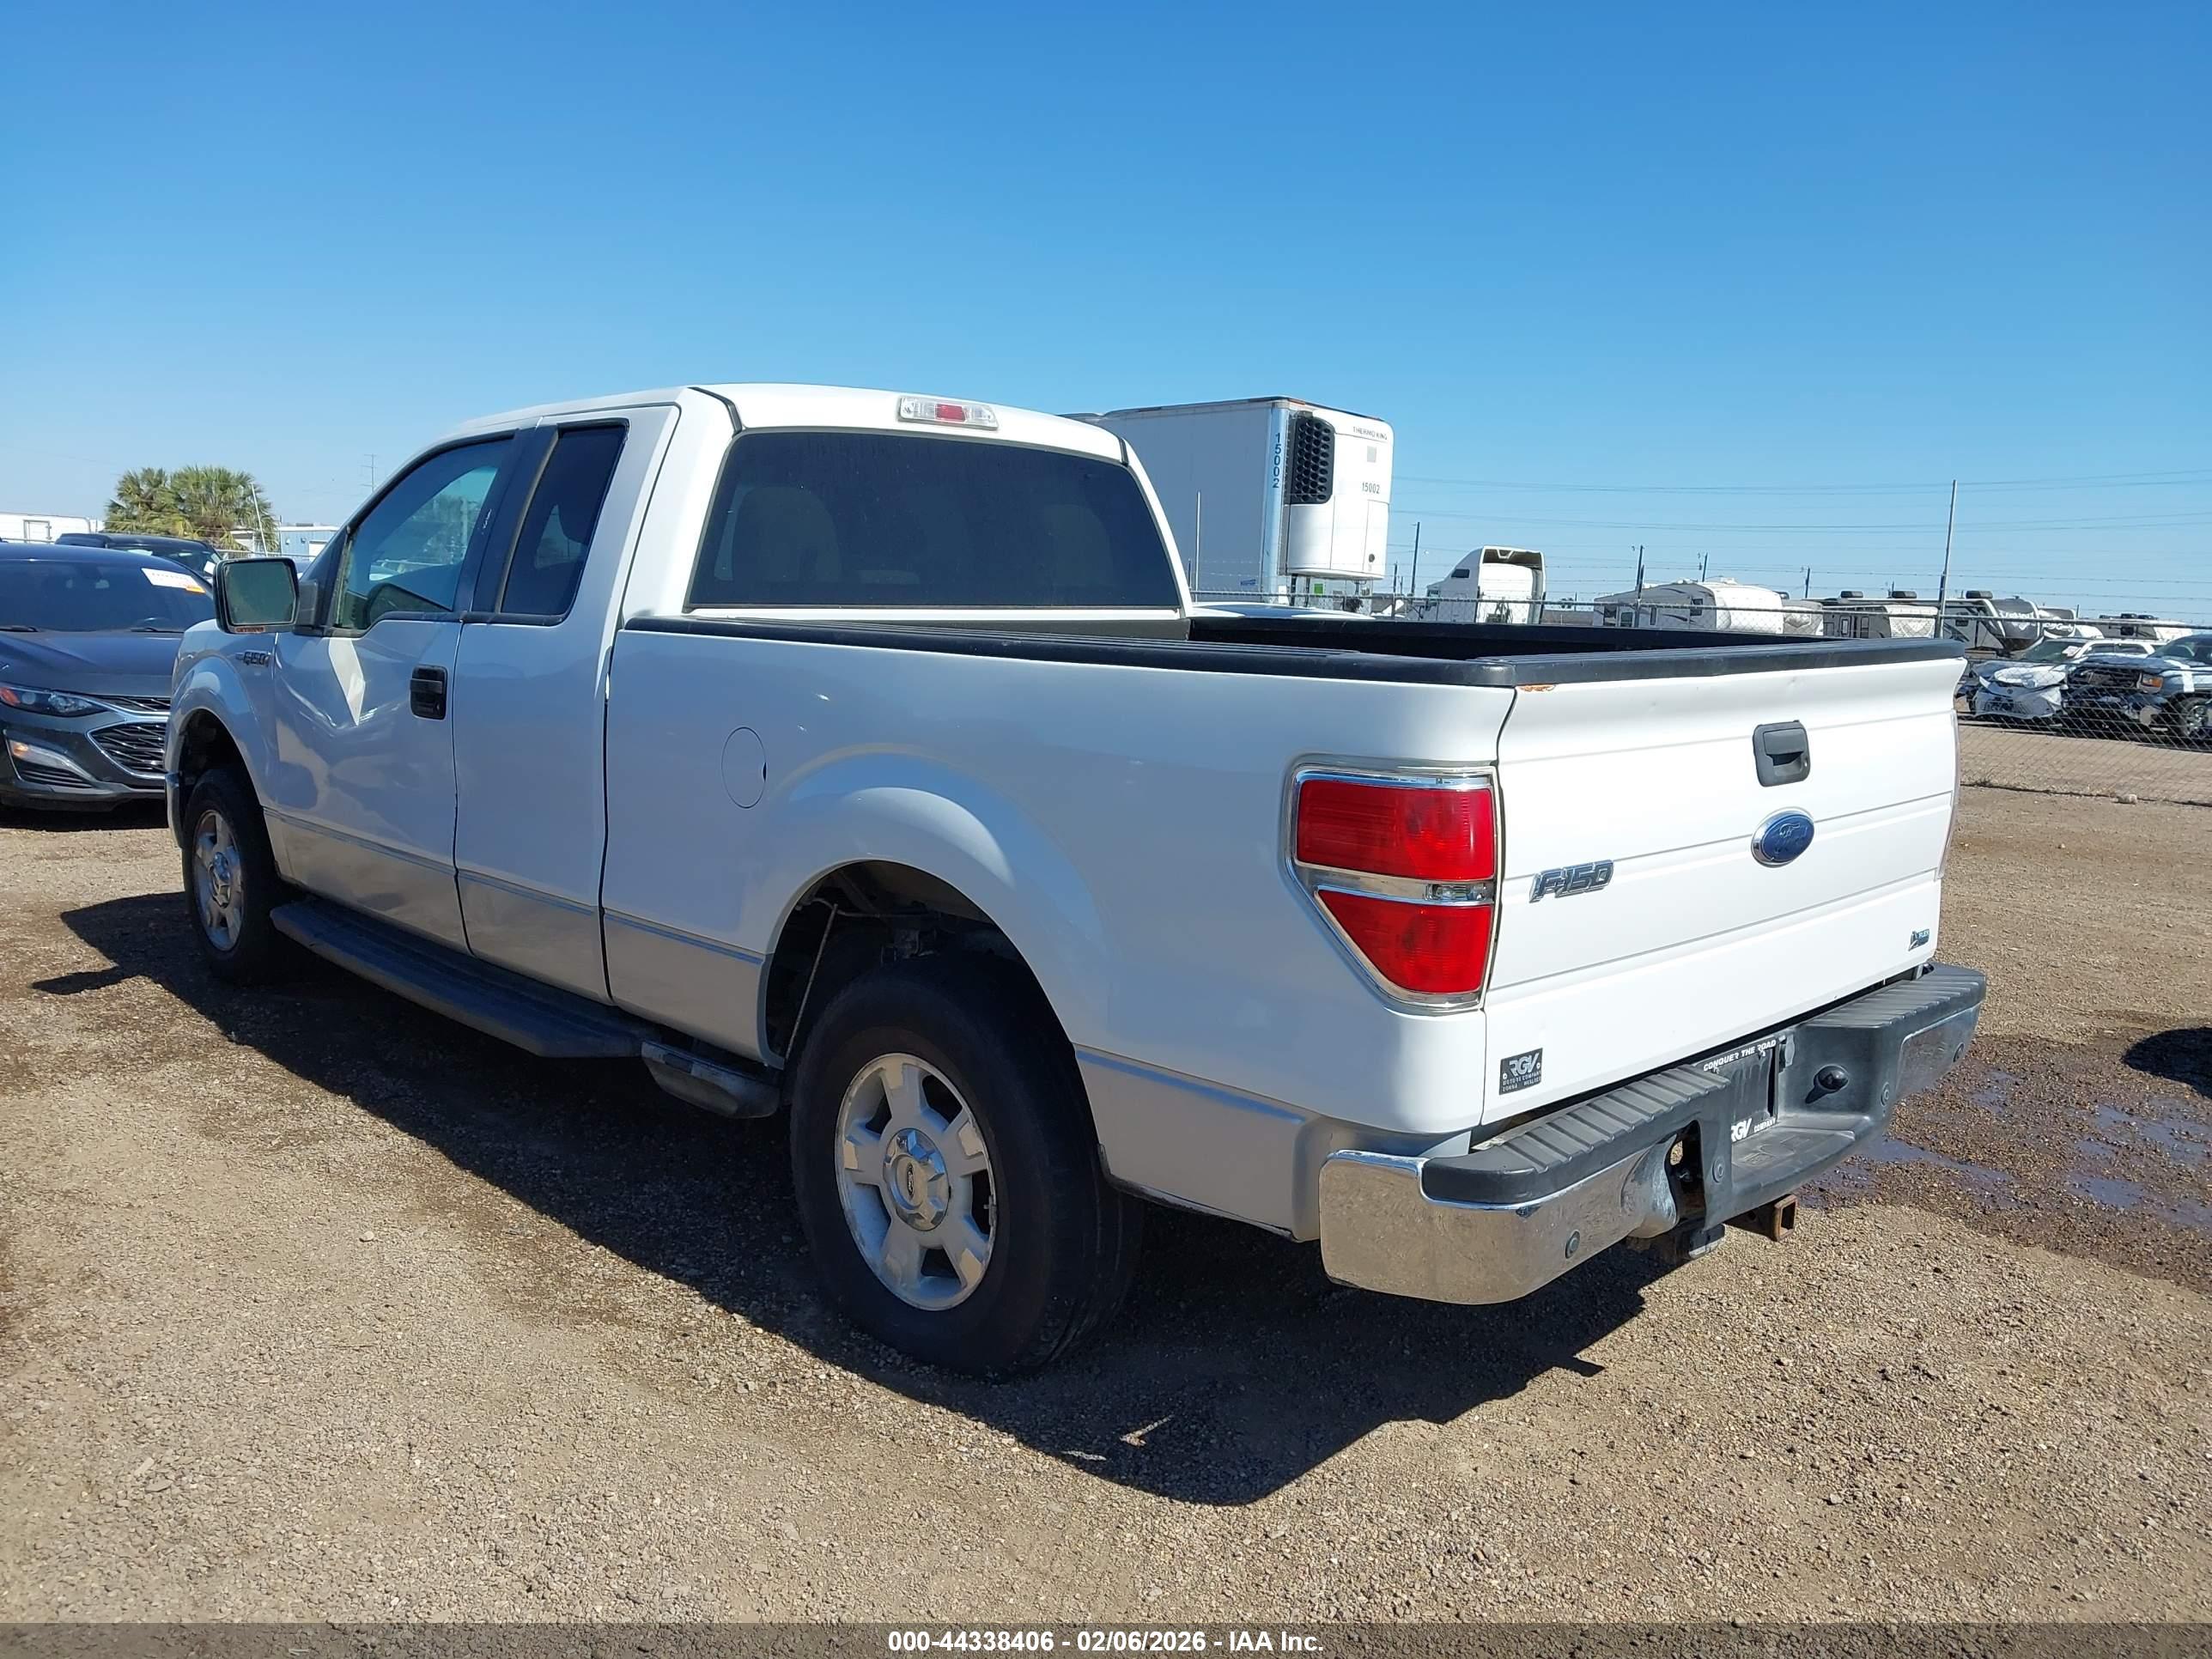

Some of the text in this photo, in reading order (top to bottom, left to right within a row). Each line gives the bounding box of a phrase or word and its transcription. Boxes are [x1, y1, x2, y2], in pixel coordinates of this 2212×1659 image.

[1353, 426, 1388, 441] THERMO KING
[1272, 432, 1282, 489] 15002
[1362, 482, 1381, 494] 15002
[1509, 1053, 1539, 1077] RGV
[1703, 1039, 1777, 1072] CONQUER THE ROAD
[1730, 1117, 1753, 1142] RGV
